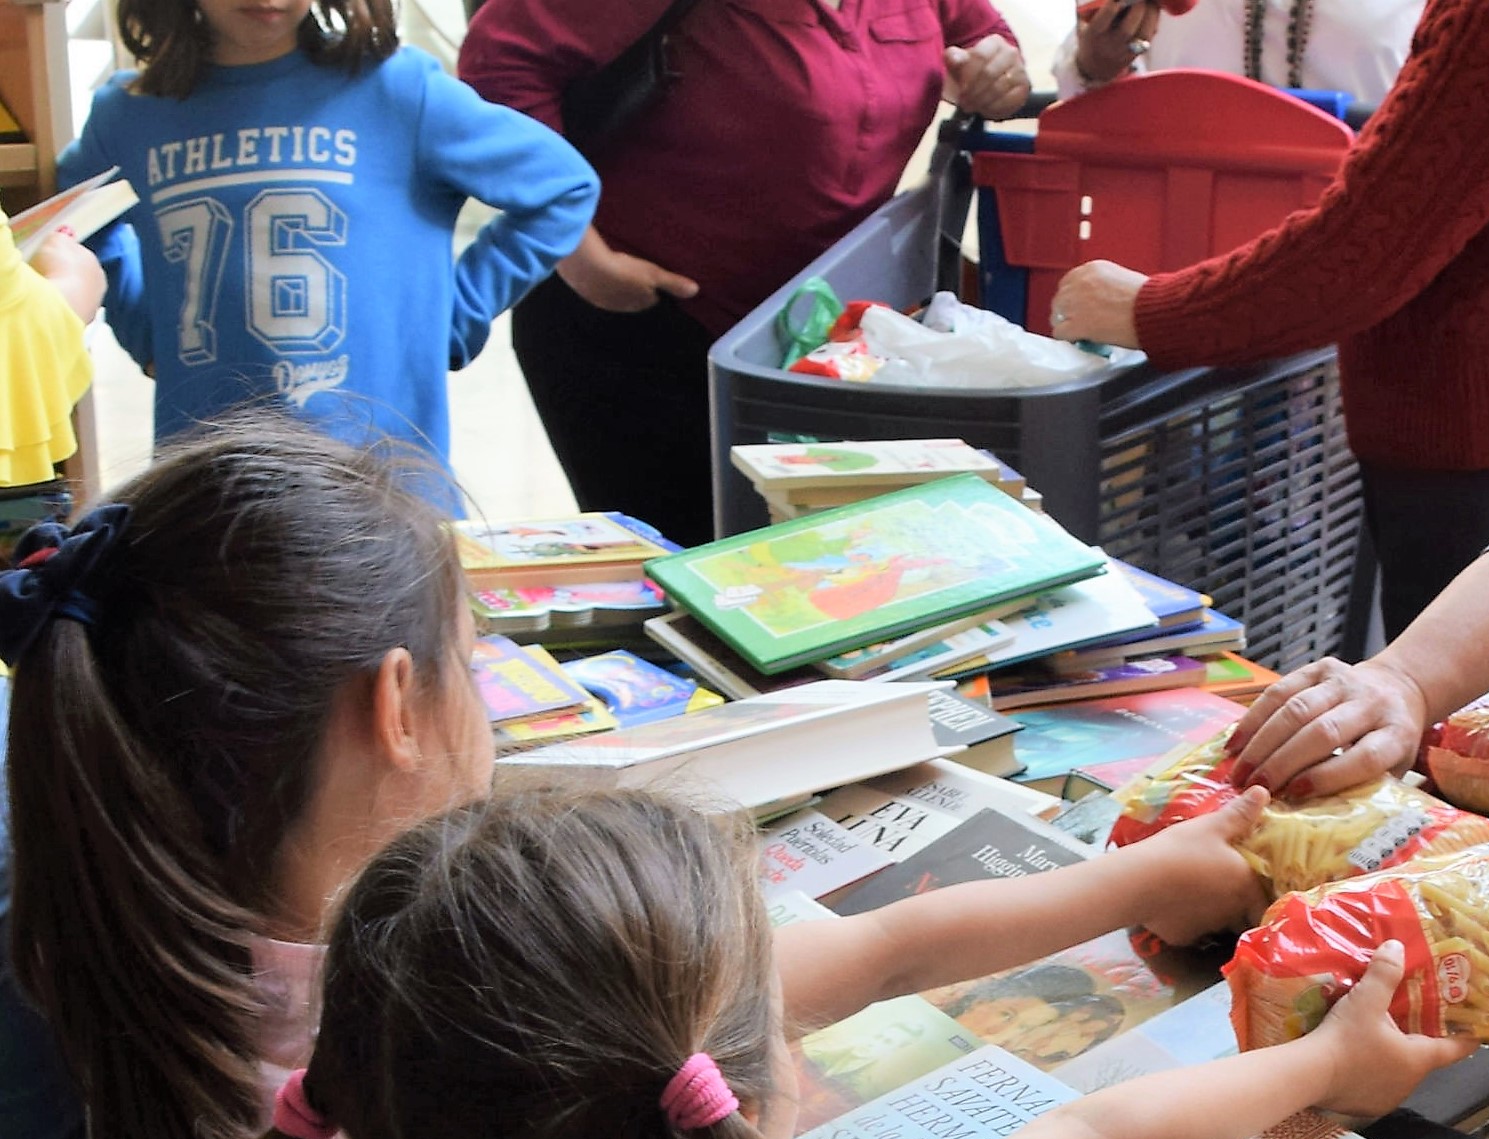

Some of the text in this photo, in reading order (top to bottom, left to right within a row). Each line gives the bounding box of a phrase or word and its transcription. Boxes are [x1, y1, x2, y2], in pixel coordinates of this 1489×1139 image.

[147, 126, 357, 186] ATHLETICS
[154, 187, 349, 366] 76
[804, 821, 859, 854] Soledad
[869, 801, 929, 831] EVA
[971, 845, 1028, 879] Higgin
[923, 1076, 1028, 1137] SAVATE
[958, 1059, 1059, 1117] FERNA
